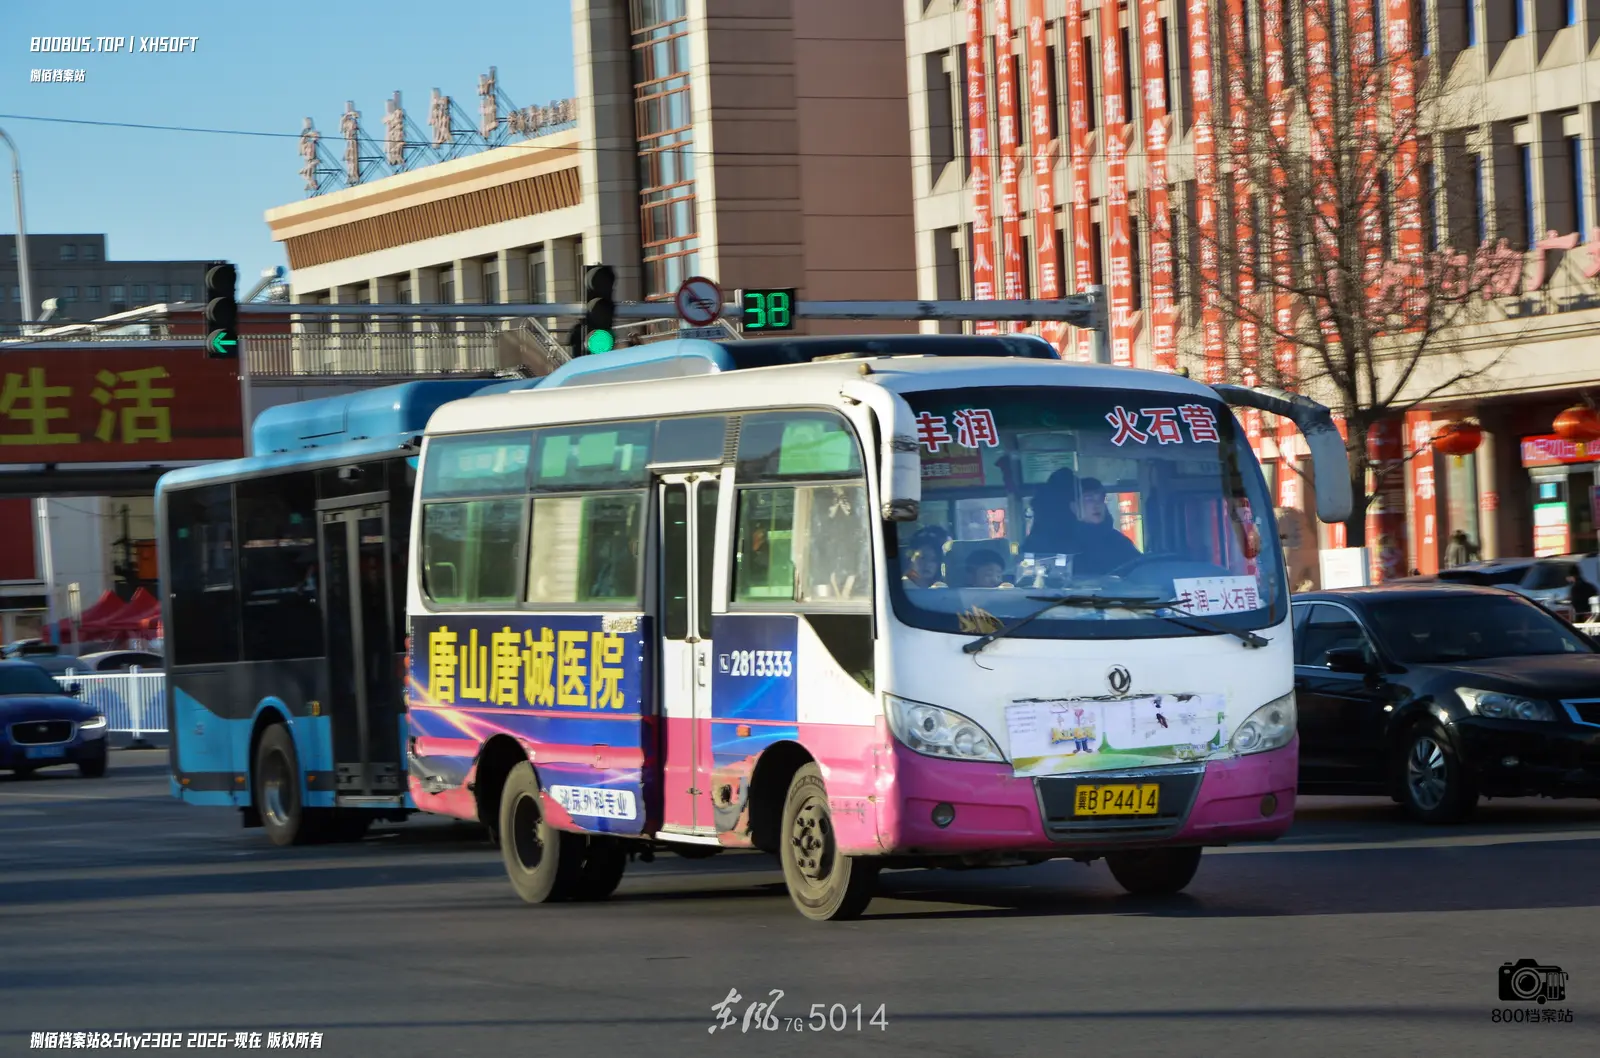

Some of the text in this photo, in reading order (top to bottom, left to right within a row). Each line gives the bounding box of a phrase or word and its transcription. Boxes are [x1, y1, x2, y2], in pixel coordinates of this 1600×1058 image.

[744, 292, 790, 328] 38
[0, 366, 175, 446] 生活
[917, 411, 999, 453] 丰润
[1106, 404, 1221, 447] 火石营
[428, 626, 625, 710] 唐山唐诚医院
[730, 649, 793, 678] 2813333
